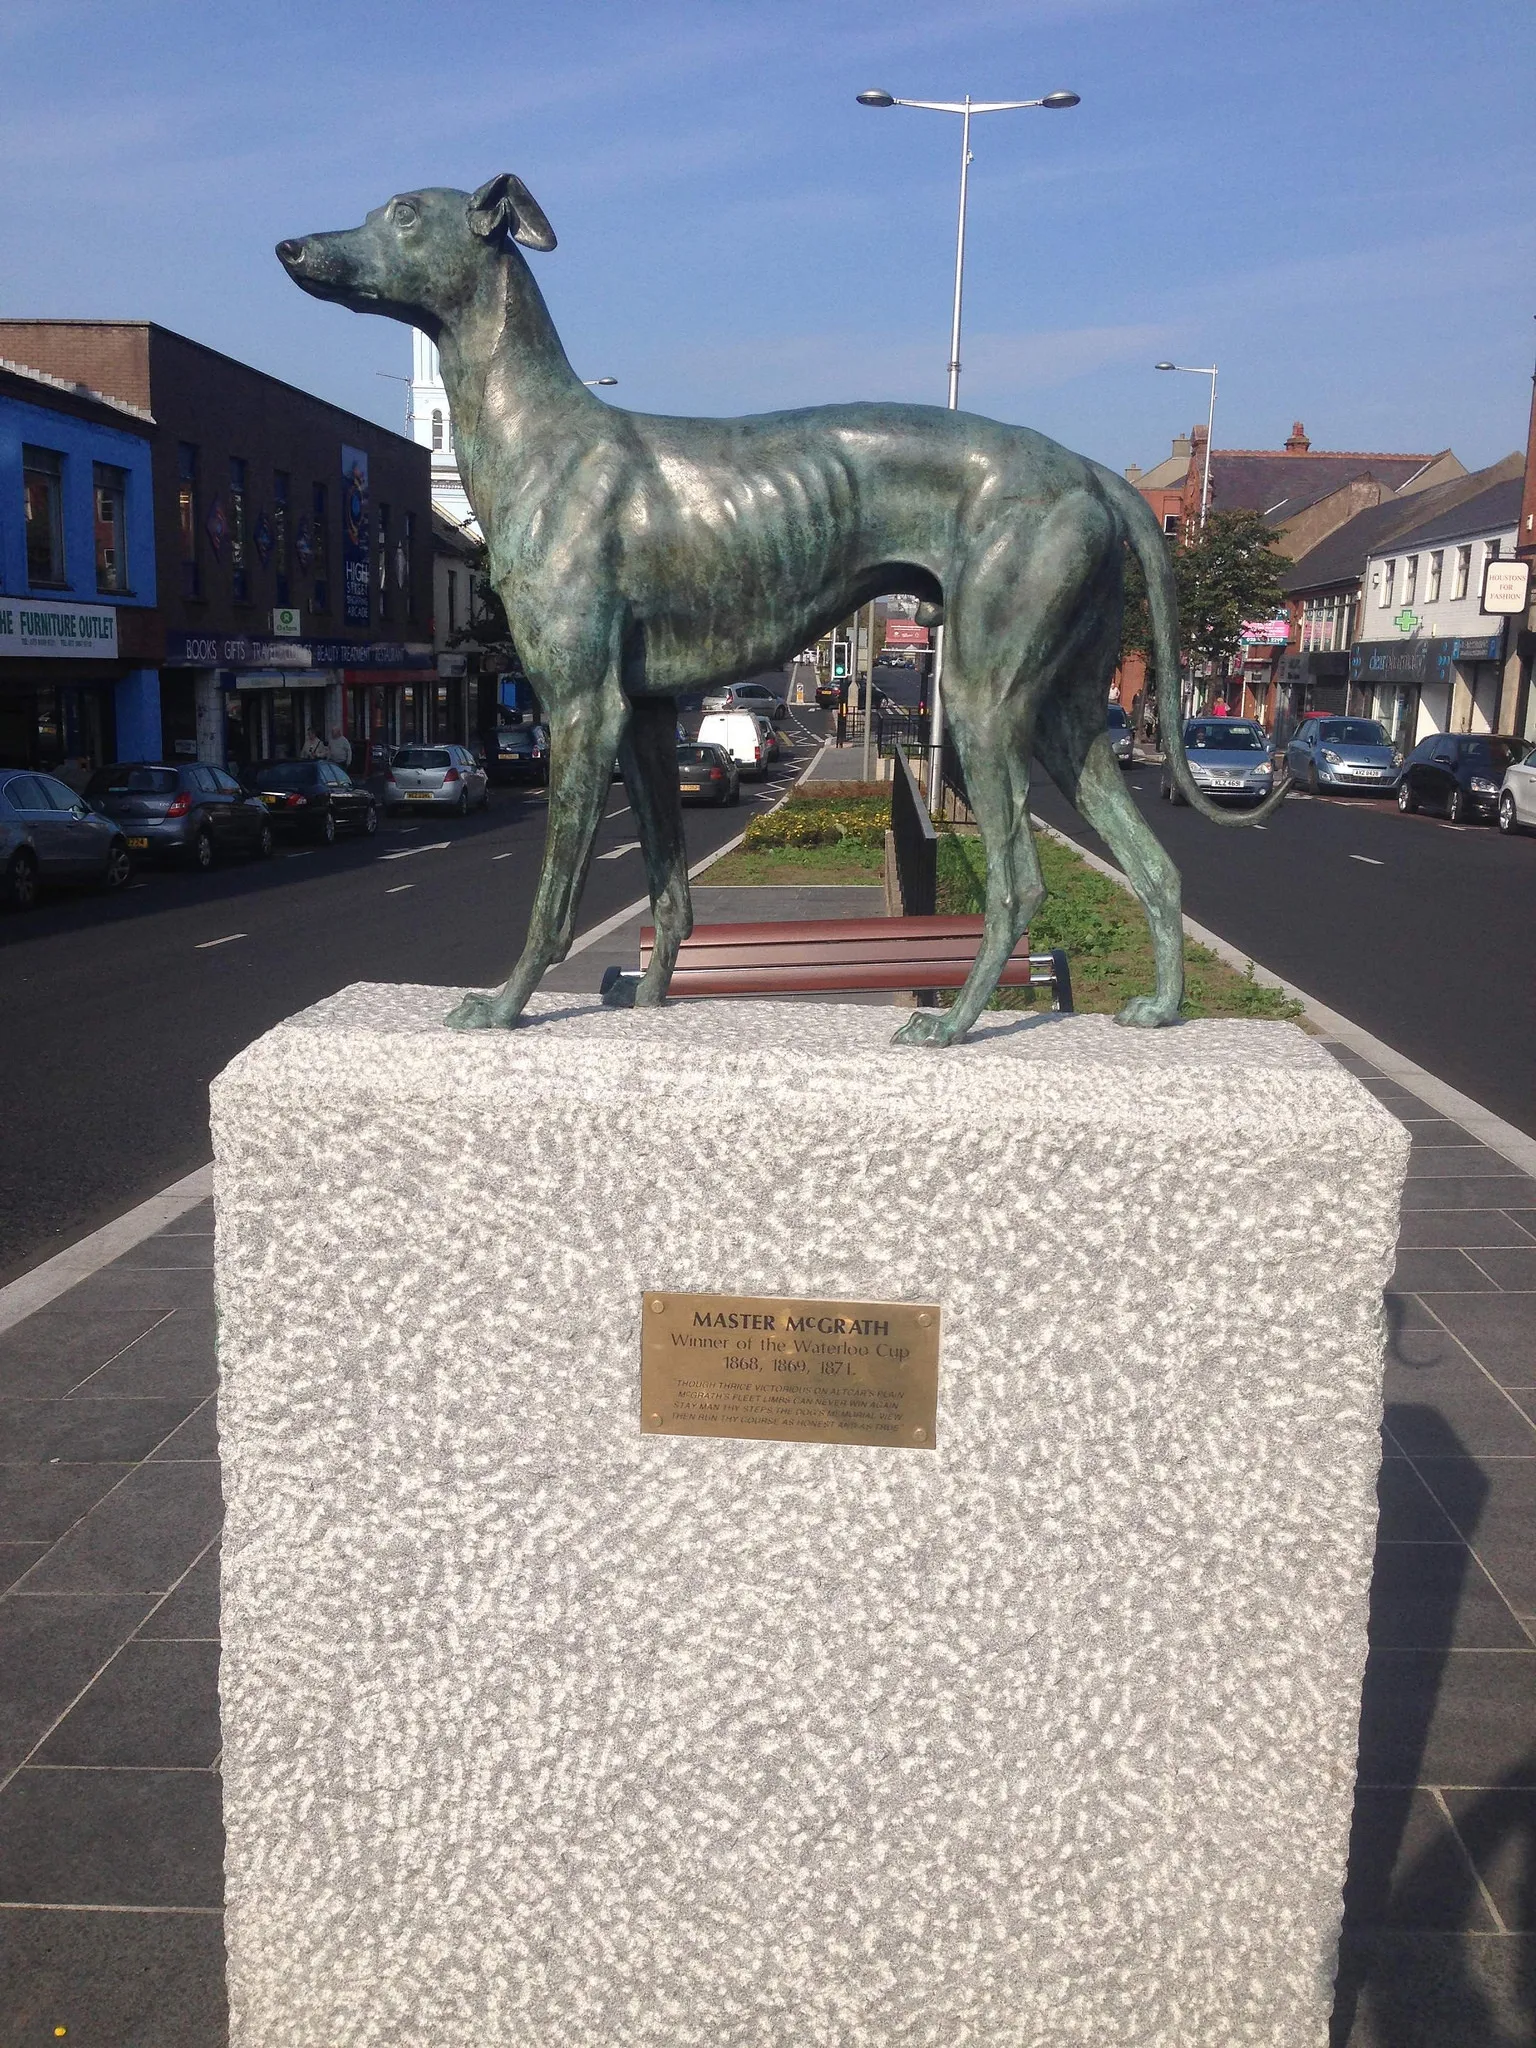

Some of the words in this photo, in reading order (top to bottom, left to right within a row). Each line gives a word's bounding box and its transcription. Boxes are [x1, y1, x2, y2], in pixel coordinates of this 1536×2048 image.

[346, 561, 368, 582] HIGH
[0, 610, 14, 634] HE
[20, 611, 77, 638] FURNITURE
[79, 615, 113, 639] OUTLET
[186, 639, 217, 660] BOOKS
[224, 640, 246, 660] GIFTS
[316, 644, 339, 661] BEAUTY
[693, 1311, 776, 1331] MASTER
[786, 1316, 889, 1336] McGRATH
[671, 1333, 730, 1349] Winner
[736, 1338, 752, 1350] of
[761, 1338, 786, 1352] the
[793, 1340, 869, 1356] Waterloo
[876, 1343, 910, 1362] Cup
[724, 1356, 763, 1373] 1868,
[771, 1358, 810, 1375] 1869,
[818, 1361, 857, 1376] 1871.
[677, 1379, 716, 1389] THOUGH
[719, 1382, 752, 1391] THRICE
[755, 1384, 812, 1394] VICTORIOUS
[814, 1387, 828, 1395] ON
[673, 1401, 697, 1410] STAY
[699, 1402, 720, 1411] MAN
[723, 1403, 740, 1412] THY
[743, 1405, 773, 1414] STEPS
[776, 1407, 795, 1416] THE
[732, 1393, 761, 1402] FLEET
[763, 1395, 791, 1404] LIMBS
[814, 1399, 847, 1407] NEVER
[849, 1400, 868, 1408] WIN
[870, 1401, 899, 1409] AGAIN
[672, 1412, 697, 1421] THEN
[698, 1413, 718, 1422] RUN
[721, 1415, 739, 1423] THY
[740, 1416, 777, 1426] COURSE
[797, 1419, 836, 1429] HONEST
